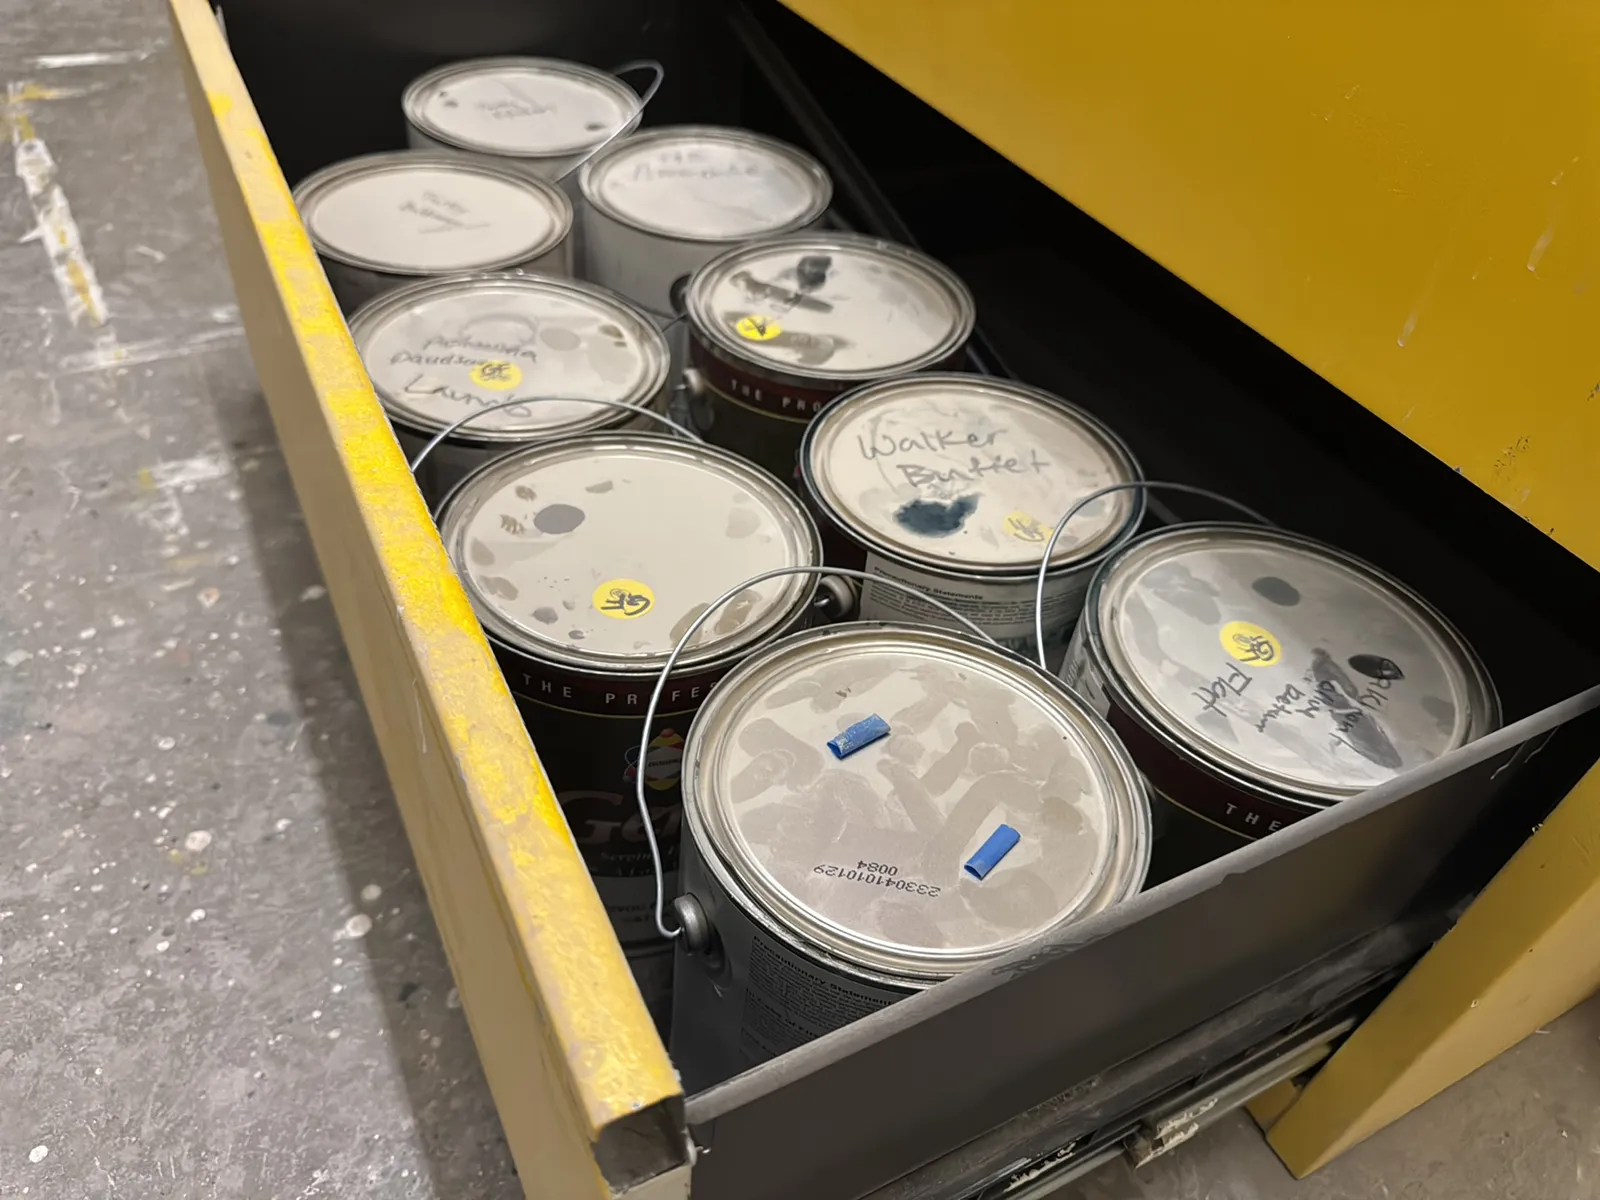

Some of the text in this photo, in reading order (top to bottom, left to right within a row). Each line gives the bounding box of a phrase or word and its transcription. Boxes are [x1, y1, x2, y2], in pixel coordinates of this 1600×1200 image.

[731, 378, 763, 402] THE
[856, 428, 1008, 461] Walker
[873, 566, 984, 601] Precautionary Statements
[601, 587, 651, 616] GF
[1232, 632, 1275, 663] GF
[522, 672, 718, 705] THE PRFE
[1191, 661, 1254, 718] Flat
[1224, 802, 1282, 832] THE
[813, 864, 941, 898] 233041010129
[856, 859, 899, 877] 0084
[753, 934, 827, 987] Precautionary
